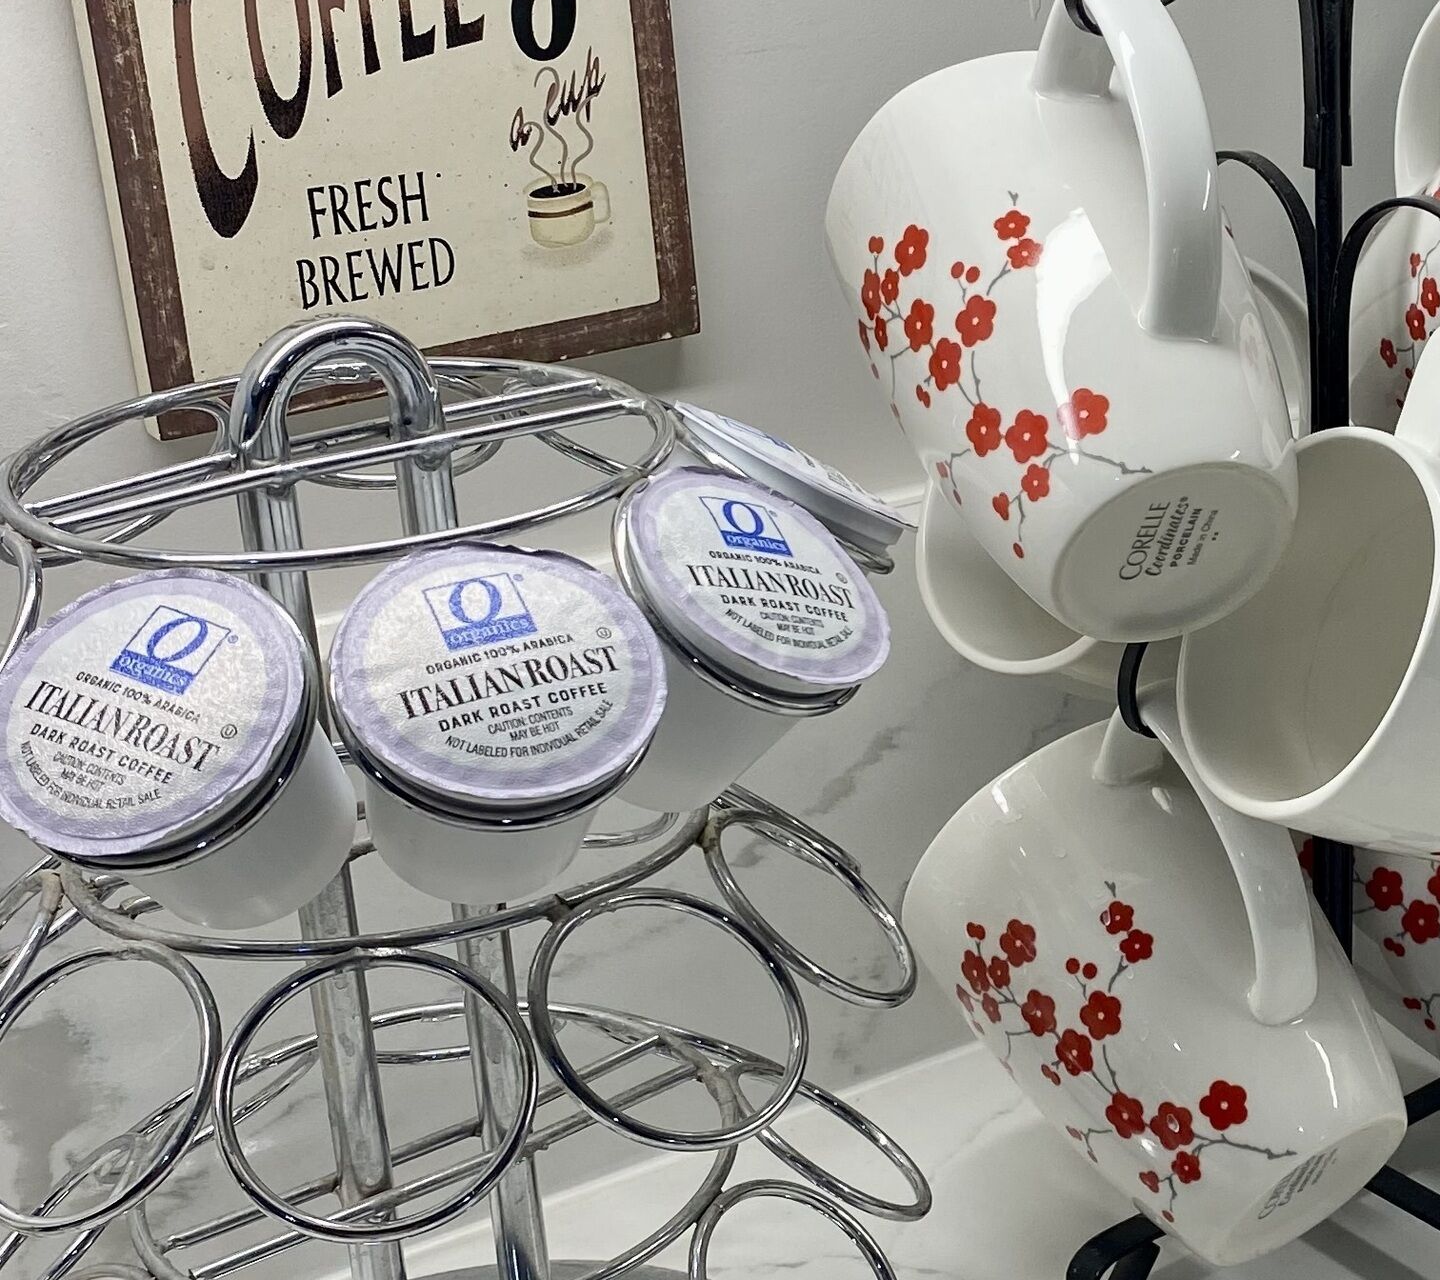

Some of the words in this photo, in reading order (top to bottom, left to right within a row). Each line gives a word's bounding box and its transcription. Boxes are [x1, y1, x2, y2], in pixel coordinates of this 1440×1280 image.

[545, 45, 607, 126] cup
[306, 170, 430, 240] FRESH
[295, 236, 456, 311] BREWED
[708, 550, 753, 563] ORGANIC
[726, 533, 788, 552] organics
[1118, 501, 1172, 581] CORELLE
[1170, 507, 1203, 568] PORCELAIN
[721, 593, 758, 607] DARK
[760, 597, 801, 613] ROAST
[805, 604, 849, 623] COFFEE
[725, 609, 744, 624] NOT
[425, 651, 482, 675] ORGANIC
[484, 643, 520, 661] 100%
[523, 632, 575, 653] ARABICA
[450, 618, 530, 646] organics
[120, 656, 188, 687] organics
[75, 671, 122, 694] ORGANIC
[122, 686, 152, 705] 100%
[153, 698, 201, 724] ARABICA
[437, 709, 484, 732] DARK
[489, 695, 542, 719] ROAST
[547, 682, 608, 704] COFFEE
[528, 705, 574, 725] CONTENTS
[445, 735, 465, 751] NOT
[465, 741, 508, 758] LABELED
[510, 744, 530, 758] FOR
[530, 732, 578, 756] INDIVIDUAL
[574, 716, 602, 738] RETAIL
[595, 698, 614, 719] SALE
[509, 729, 529, 742] MAY
[530, 725, 542, 737] BE
[543, 720, 561, 734] HOT
[30, 723, 67, 745] DARK
[69, 736, 117, 761] ROAST
[118, 754, 173, 784] COFFEE
[138, 787, 162, 805] SALE
